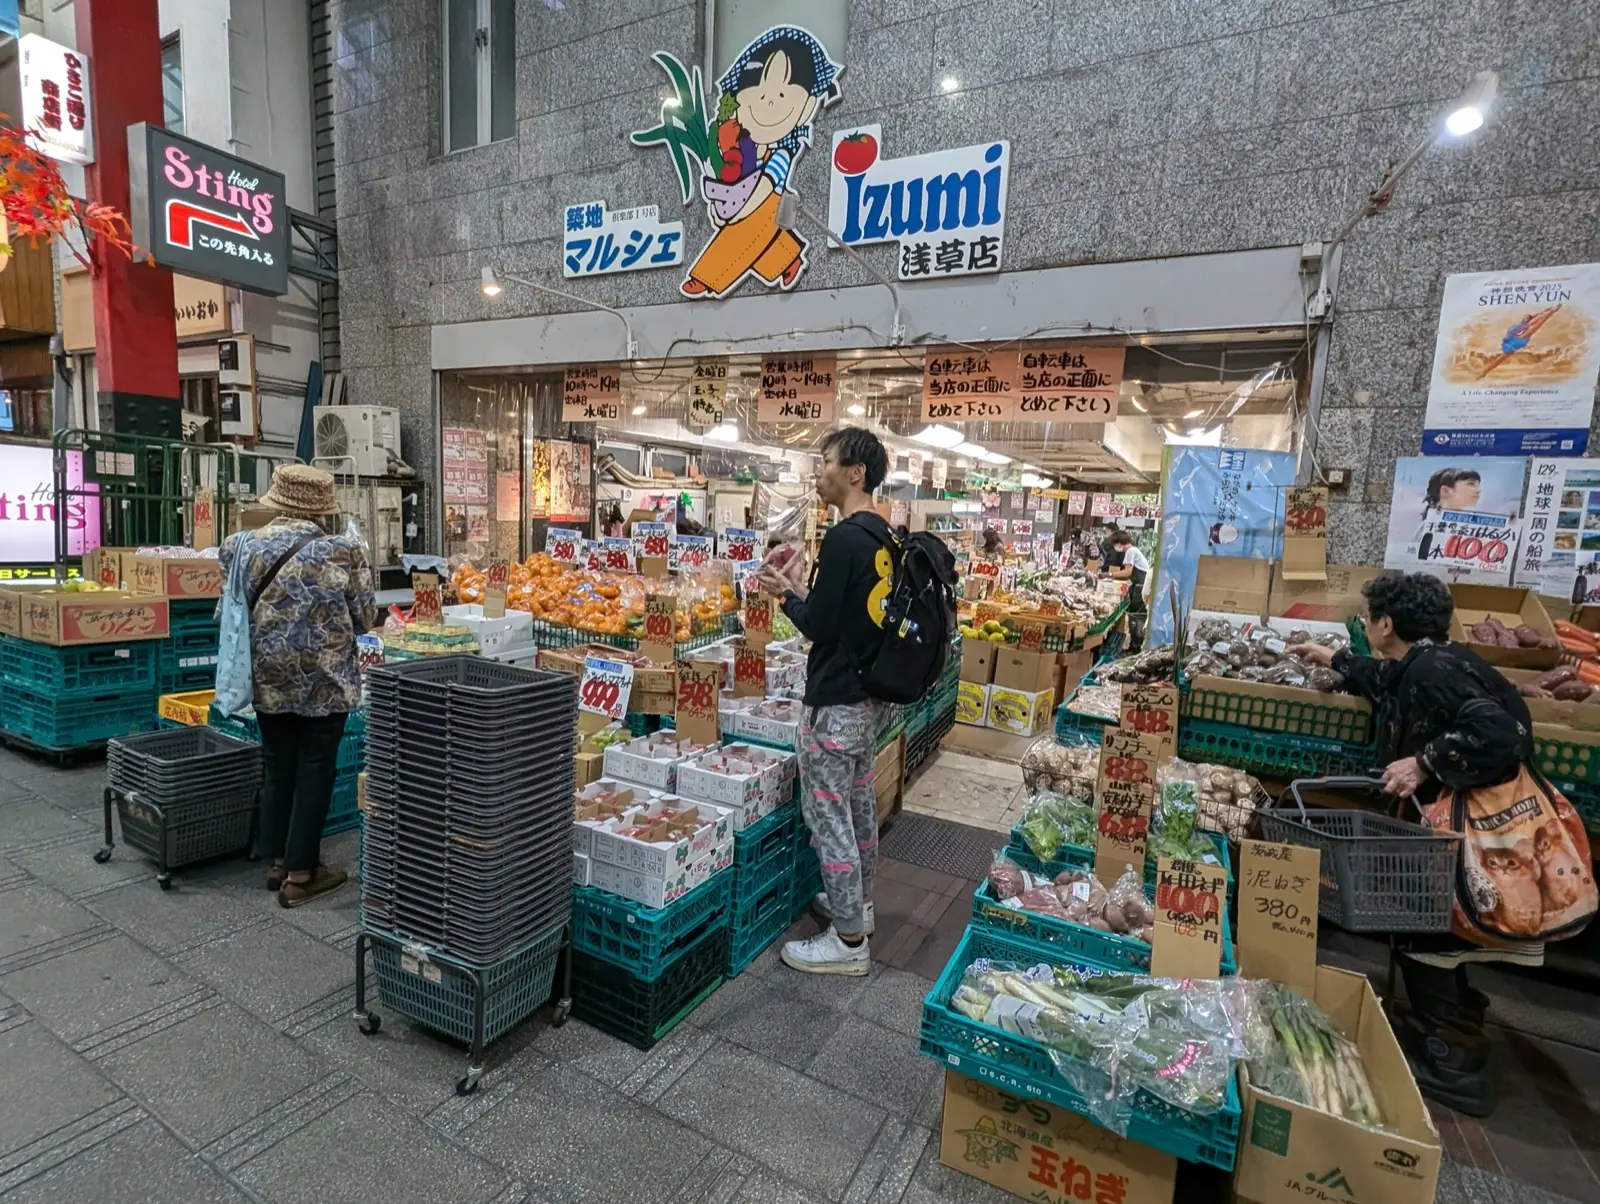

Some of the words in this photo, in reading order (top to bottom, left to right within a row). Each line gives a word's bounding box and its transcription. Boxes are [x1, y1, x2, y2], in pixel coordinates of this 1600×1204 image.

[164, 146, 274, 234] Sting
[227, 170, 258, 191] Hotel
[842, 144, 1002, 243] Izumi
[567, 204, 603, 232] 築地
[199, 234, 273, 266] この先角入る
[901, 236, 1000, 277] 浅草店
[1540, 283, 1562, 292] 2025
[1478, 293, 1527, 306] SHEN
[1534, 290, 1571, 303] YUN
[765, 360, 812, 372] 営業時間
[929, 358, 992, 376] 自転車は
[1023, 352, 1087, 369] 自転車は
[694, 365, 725, 378] 金曜日
[1022, 369, 1111, 388] 当店の正面に
[929, 376, 1011, 395] 当店の正面に
[1519, 388, 1560, 396] Experience
[584, 404, 616, 418] 水曜日
[779, 400, 820, 418] 水曜日
[928, 401, 1002, 418] とめて下さい
[1021, 396, 1110, 416] とめて下さい
[1523, 483, 1554, 572] 地球一周の船旅
[1246, 869, 1311, 894] 泥ねぎ
[999, 1119, 1054, 1148] 北海道産
[1028, 1145, 1129, 1204] 玉ねぎ
[1285, 1178, 1358, 1204] JAグルー
